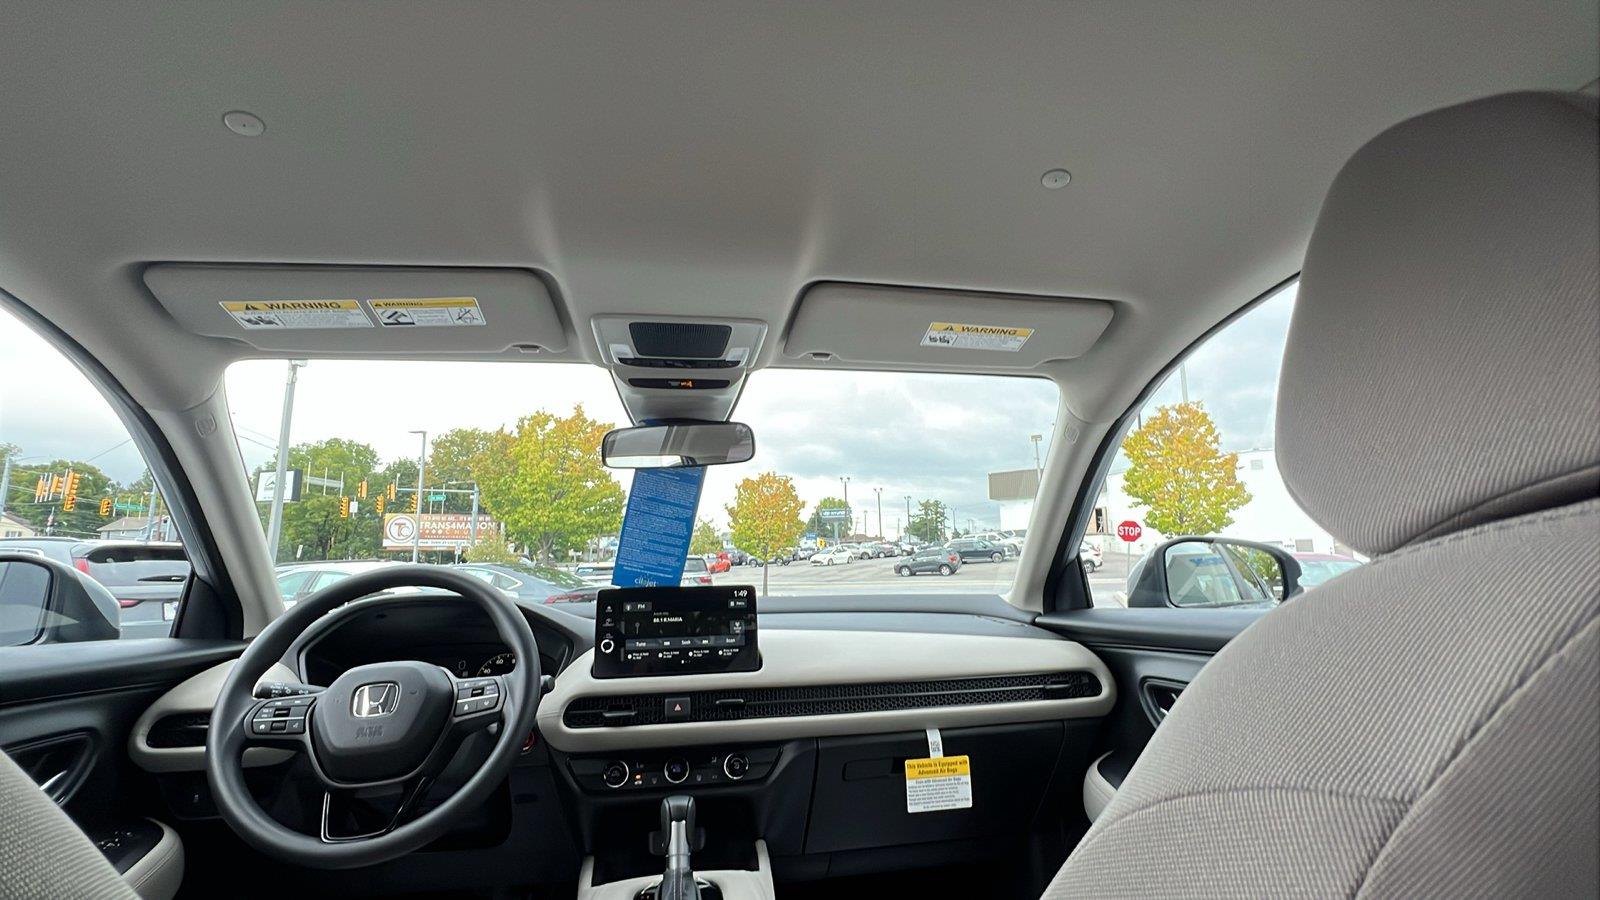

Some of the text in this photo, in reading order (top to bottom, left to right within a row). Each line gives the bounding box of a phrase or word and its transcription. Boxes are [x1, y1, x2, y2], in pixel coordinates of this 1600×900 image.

[264, 301, 341, 310] WARNING
[961, 325, 1018, 336] WARNING
[419, 521, 495, 530] TRANS4MAION
[1118, 526, 1141, 537] STOP
[733, 589, 748, 598] 1:49
